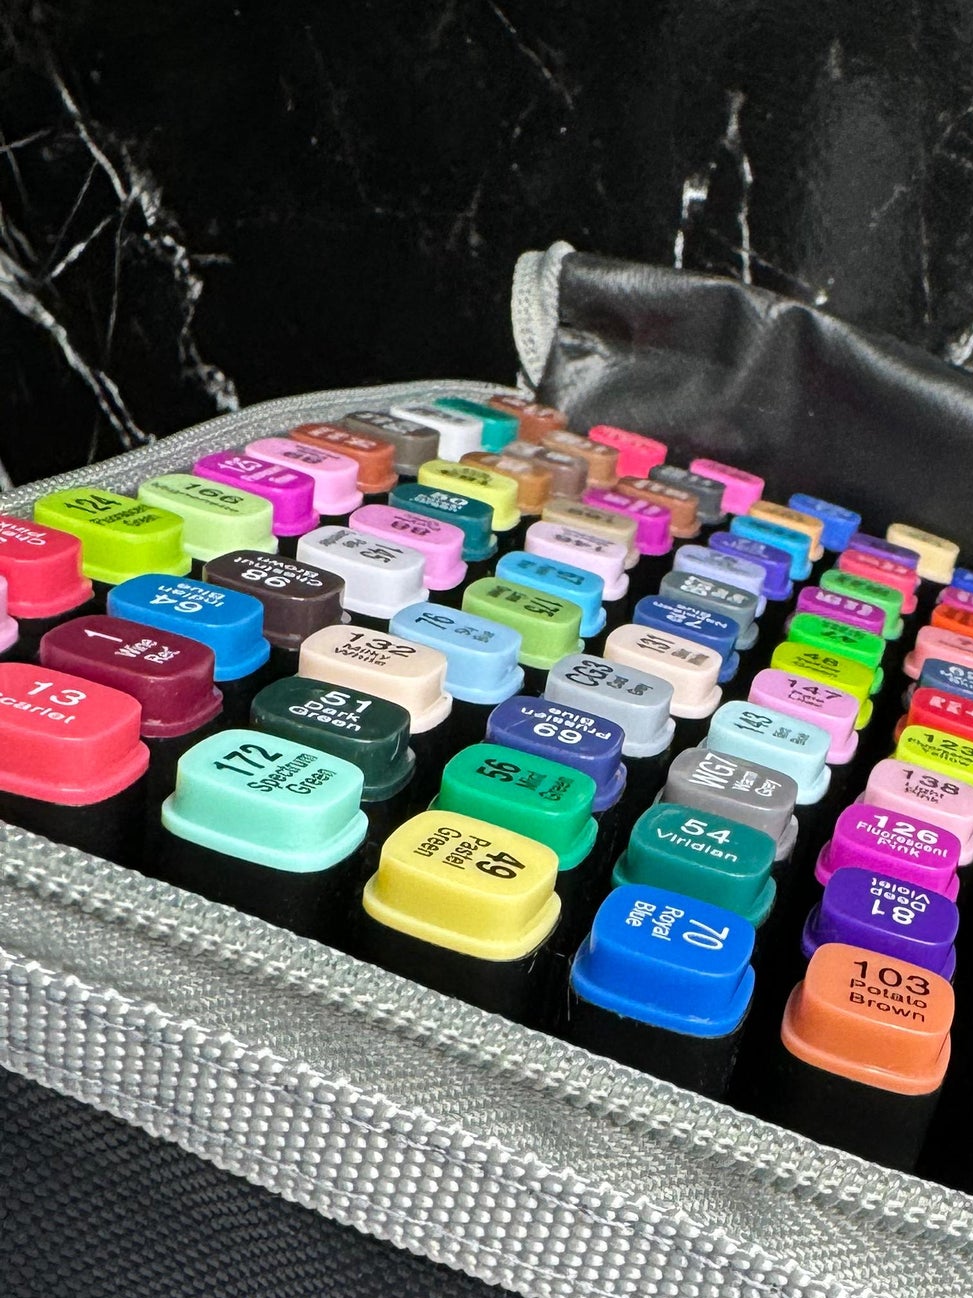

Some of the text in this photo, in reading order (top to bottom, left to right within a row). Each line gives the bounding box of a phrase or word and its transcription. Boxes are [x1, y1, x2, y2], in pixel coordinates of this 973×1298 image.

[64, 494, 123, 514] 124
[184, 483, 244, 505] 166
[359, 543, 404, 564] 145
[176, 582, 225, 600] Blue
[241, 568, 291, 588] 98
[150, 594, 204, 613] 64
[158, 585, 225, 607] Indian
[415, 612, 455, 630] 76
[84, 629, 124, 642] 1
[114, 638, 158, 658] Wine
[349, 632, 416, 658] 132
[636, 633, 676, 654] 131
[144, 646, 182, 664] Red
[565, 660, 615, 687] CG3
[28, 681, 87, 706] 13
[787, 678, 842, 700] 147
[304, 700, 360, 722] Dark
[320, 691, 373, 714] 51
[288, 705, 361, 732] Green
[549, 707, 595, 726] Blue
[734, 711, 773, 735] 143
[533, 722, 583, 744] 69
[214, 744, 283, 776] 172
[247, 753, 319, 792] Spectrum
[476, 758, 521, 782] 56
[688, 752, 738, 790] WG7
[285, 768, 337, 796] Green
[902, 768, 961, 796] 138
[414, 827, 462, 857] Green
[680, 818, 733, 845] 54
[856, 821, 948, 858] Fluorescent
[873, 814, 940, 844] 126
[442, 835, 492, 870] Pastel
[656, 828, 738, 863] Viridian
[877, 836, 920, 858] Pink
[475, 852, 526, 879] 49
[870, 887, 928, 913] Deep
[871, 877, 931, 905] Violet
[625, 900, 657, 927] Blue
[651, 905, 685, 942] Royal
[871, 899, 916, 925] 81
[682, 918, 730, 951] 70
[853, 960, 931, 996] 103
[850, 978, 928, 1009] Potato
[849, 991, 926, 1023] Brown
